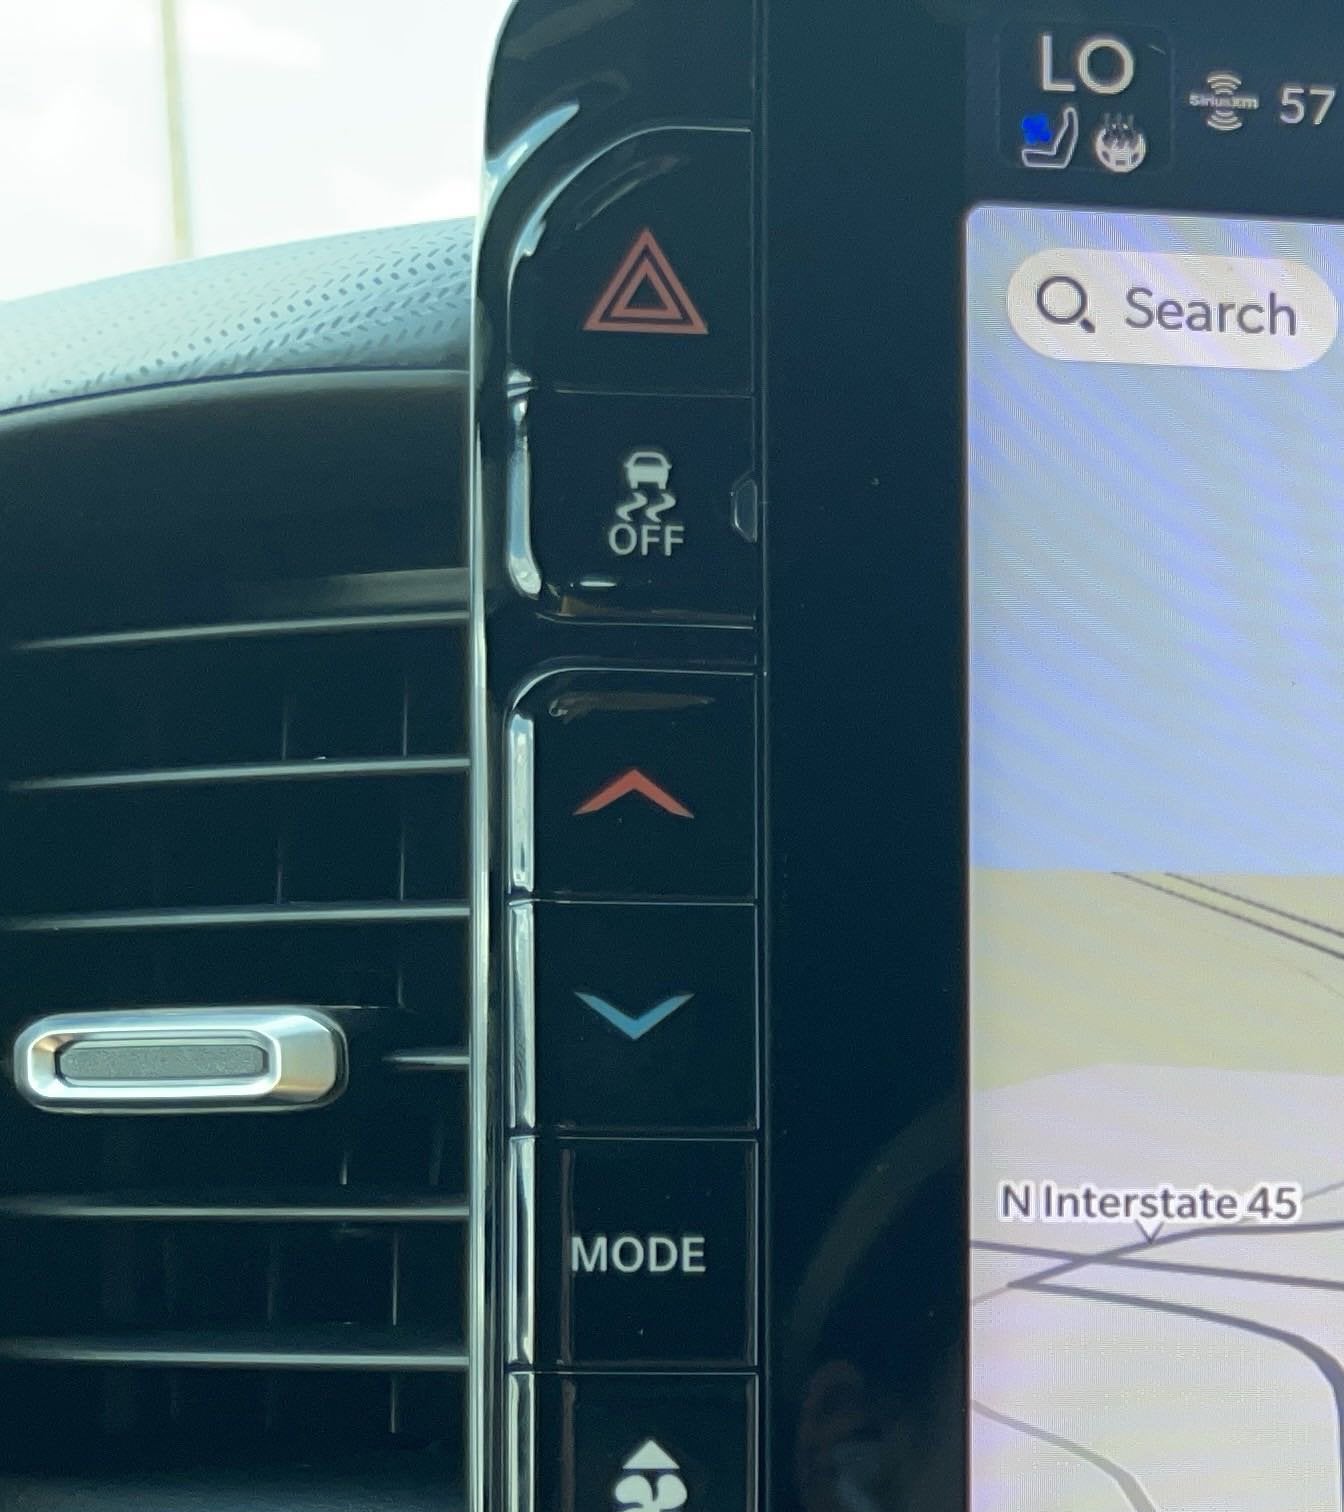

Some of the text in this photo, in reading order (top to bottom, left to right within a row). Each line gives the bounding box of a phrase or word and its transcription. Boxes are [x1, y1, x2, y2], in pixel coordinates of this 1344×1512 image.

[1041, 34, 1133, 95] LO
[1281, 84, 1336, 125] 57
[1126, 287, 1297, 336] Search
[608, 523, 685, 556] OFF
[1002, 1184, 1298, 1219] N Interstate 45
[571, 1236, 706, 1272] MODE
